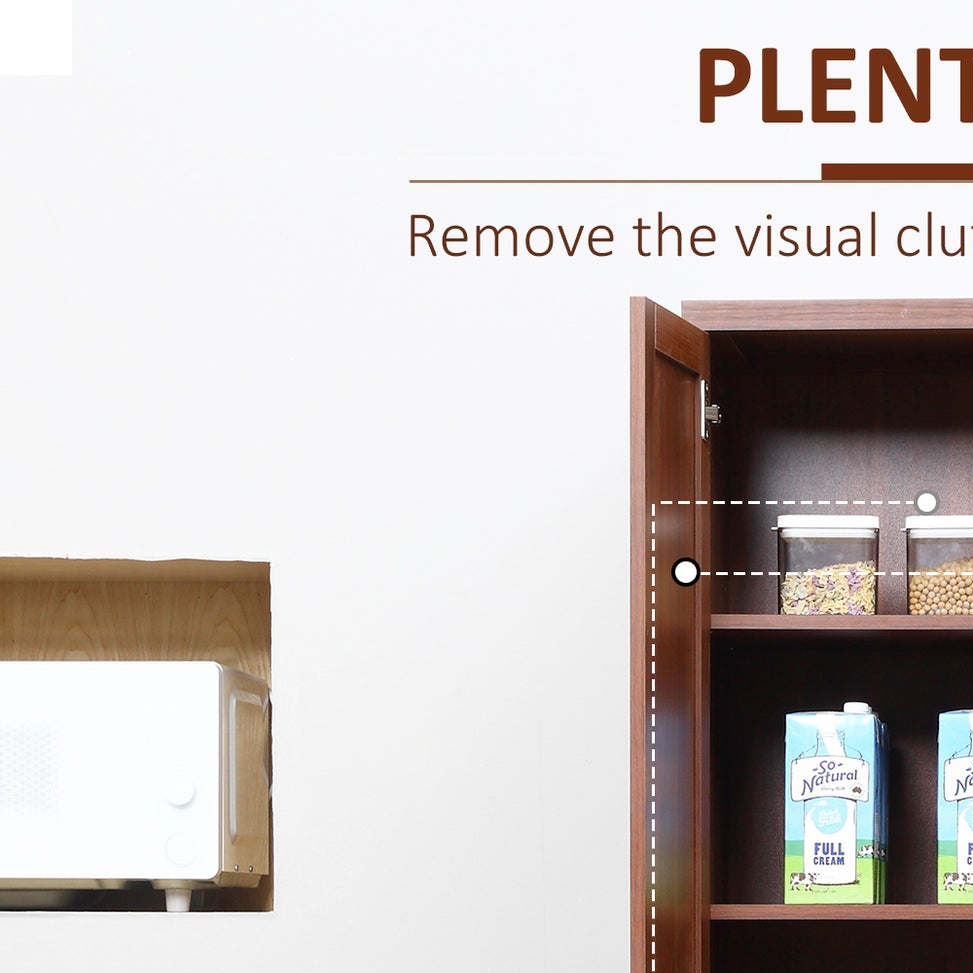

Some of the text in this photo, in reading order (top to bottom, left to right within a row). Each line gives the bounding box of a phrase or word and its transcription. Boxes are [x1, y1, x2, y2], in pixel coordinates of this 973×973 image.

[801, 769, 858, 796] Natural
[814, 842, 845, 856] FULL
[813, 857, 845, 866] CREAM
